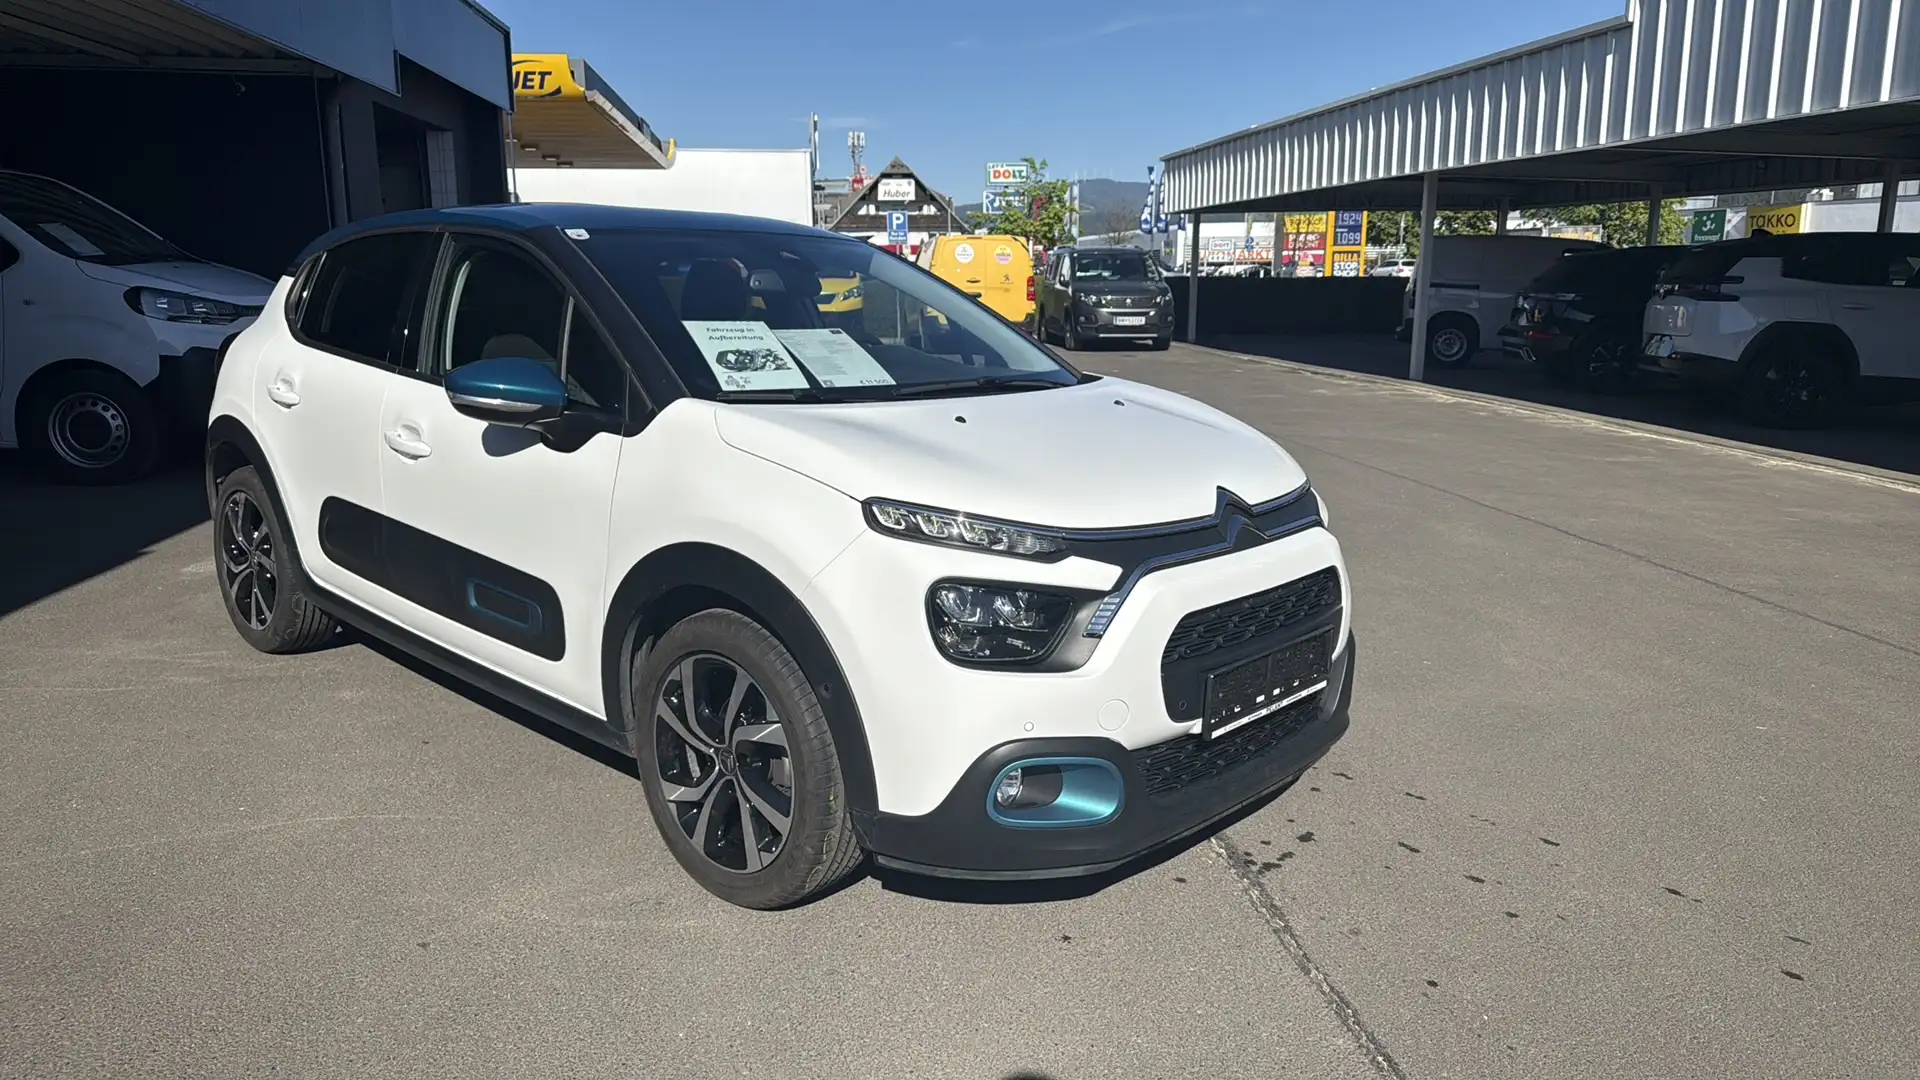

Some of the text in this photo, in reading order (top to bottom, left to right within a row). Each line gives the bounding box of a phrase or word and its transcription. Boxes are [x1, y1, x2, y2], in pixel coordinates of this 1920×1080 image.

[514, 71, 552, 90] JET
[883, 189, 911, 198] Huber
[892, 213, 904, 230] P
[1334, 253, 1359, 262] BILLA
